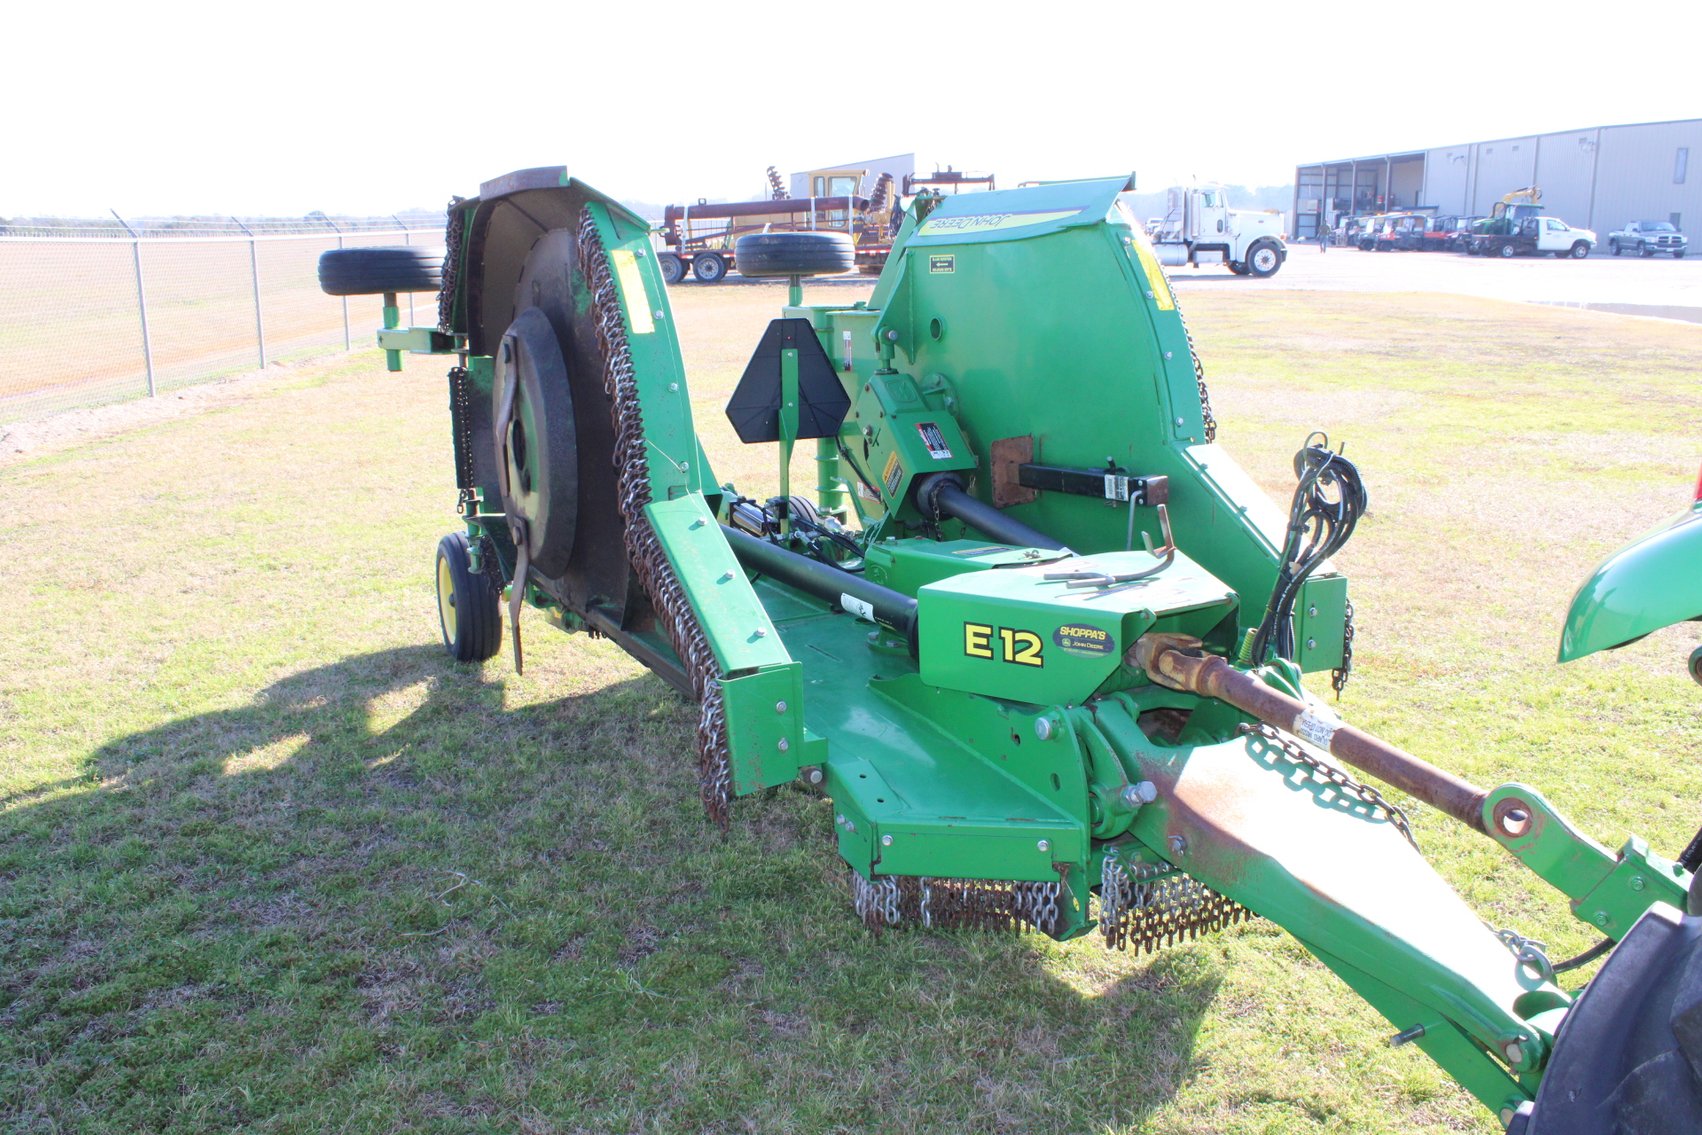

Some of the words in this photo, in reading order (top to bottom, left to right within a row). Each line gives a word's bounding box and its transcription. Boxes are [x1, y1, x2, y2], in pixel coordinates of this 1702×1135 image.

[929, 217, 974, 229] DEERE
[971, 214, 1010, 227] JOHN
[1060, 626, 1106, 640] SHOPPA'S
